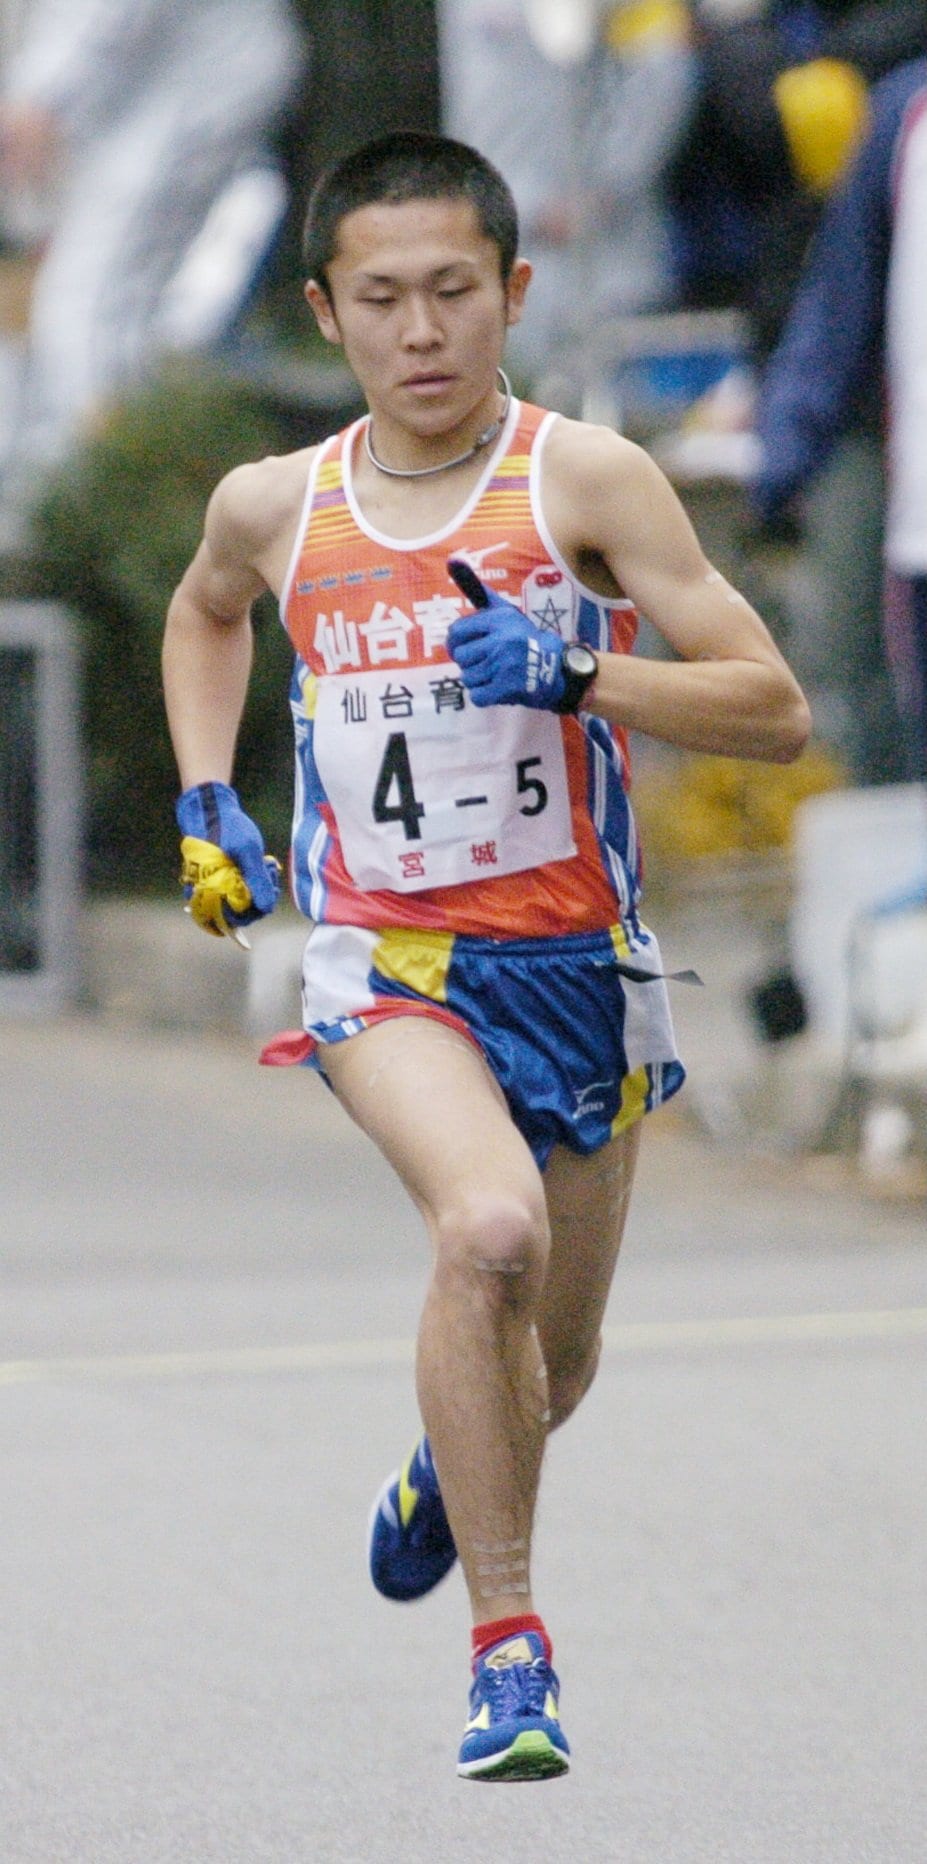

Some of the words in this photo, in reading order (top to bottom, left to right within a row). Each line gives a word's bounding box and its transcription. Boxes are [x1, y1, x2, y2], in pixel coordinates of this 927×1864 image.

[313, 593, 526, 674] 仙台育
[398, 840, 498, 878] 宮城
